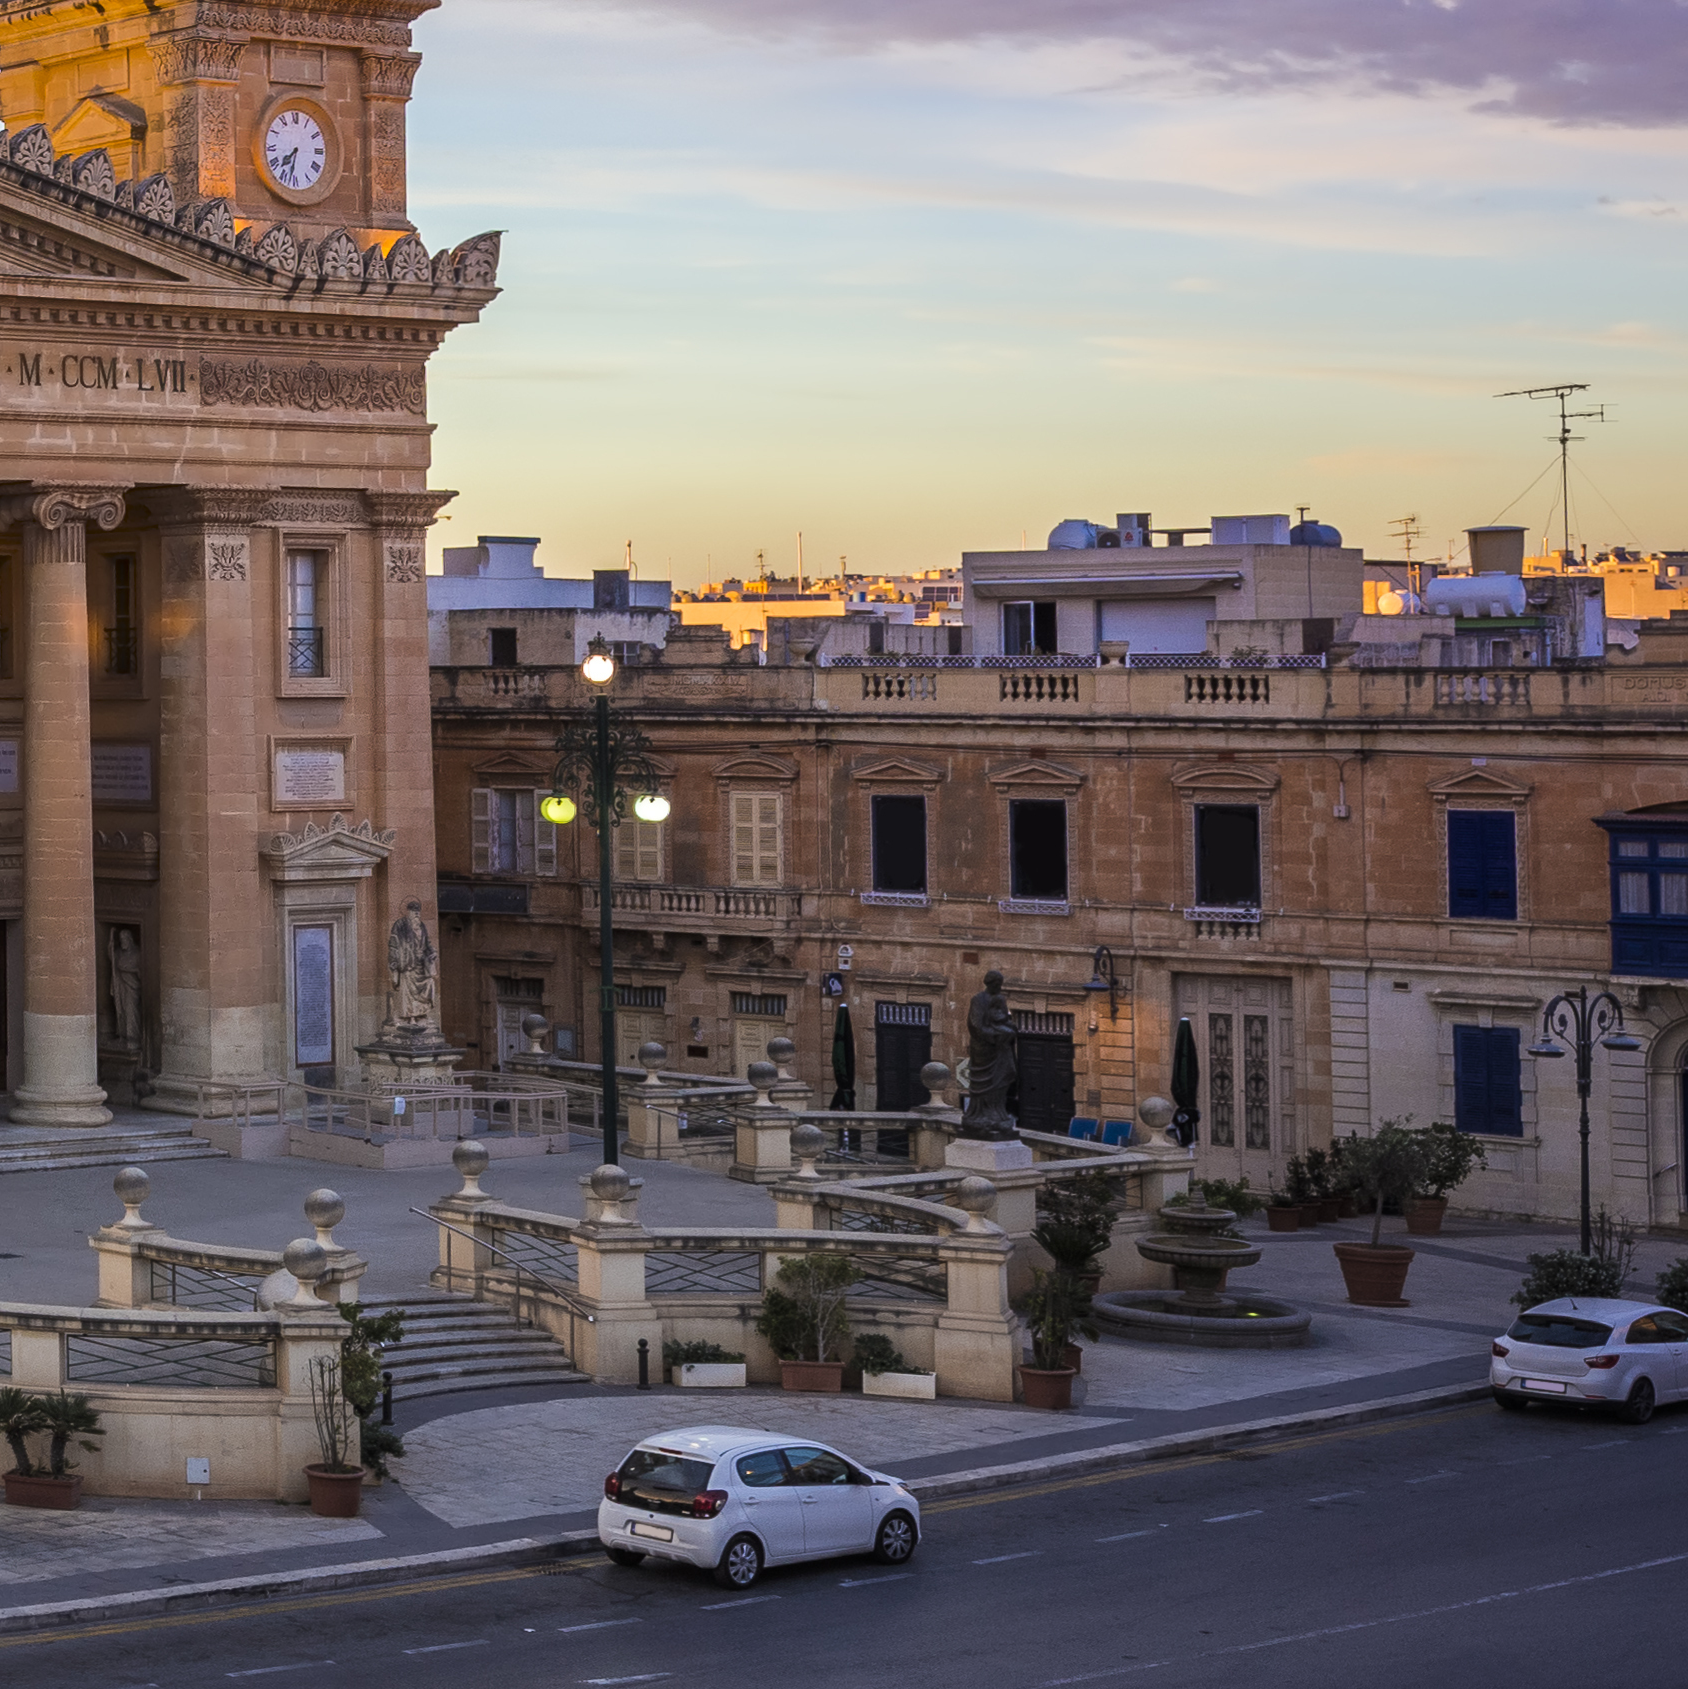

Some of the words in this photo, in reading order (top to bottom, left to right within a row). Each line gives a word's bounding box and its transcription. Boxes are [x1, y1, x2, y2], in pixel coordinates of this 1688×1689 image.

[311, 131, 320, 140] II
[19, 352, 42, 387] M
[61, 354, 119, 390] CCM
[1624, 677, 1686, 690] DOMUS
